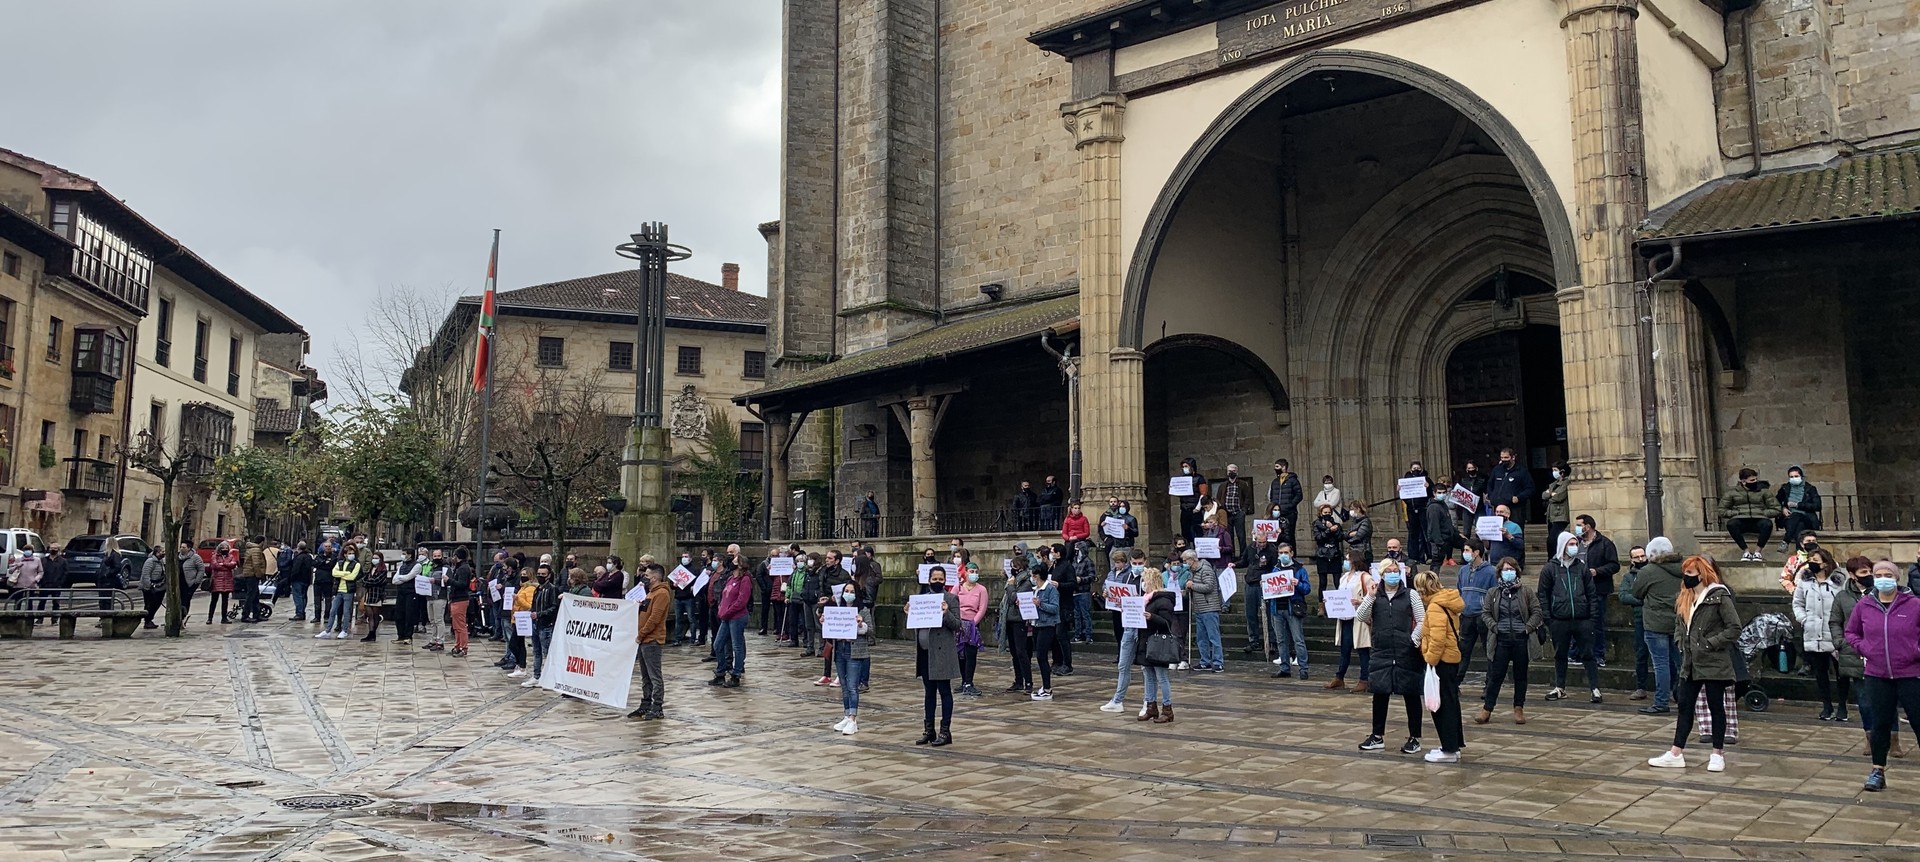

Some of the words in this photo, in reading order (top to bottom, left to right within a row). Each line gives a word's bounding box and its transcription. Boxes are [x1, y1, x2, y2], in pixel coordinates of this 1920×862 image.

[1245, 13, 1277, 31] TOTA
[1266, 573, 1288, 587] SOS
[1109, 586, 1131, 598] SOS
[565, 619, 613, 642] OSTALARITZA
[566, 655, 595, 677] BIZIRIK!
